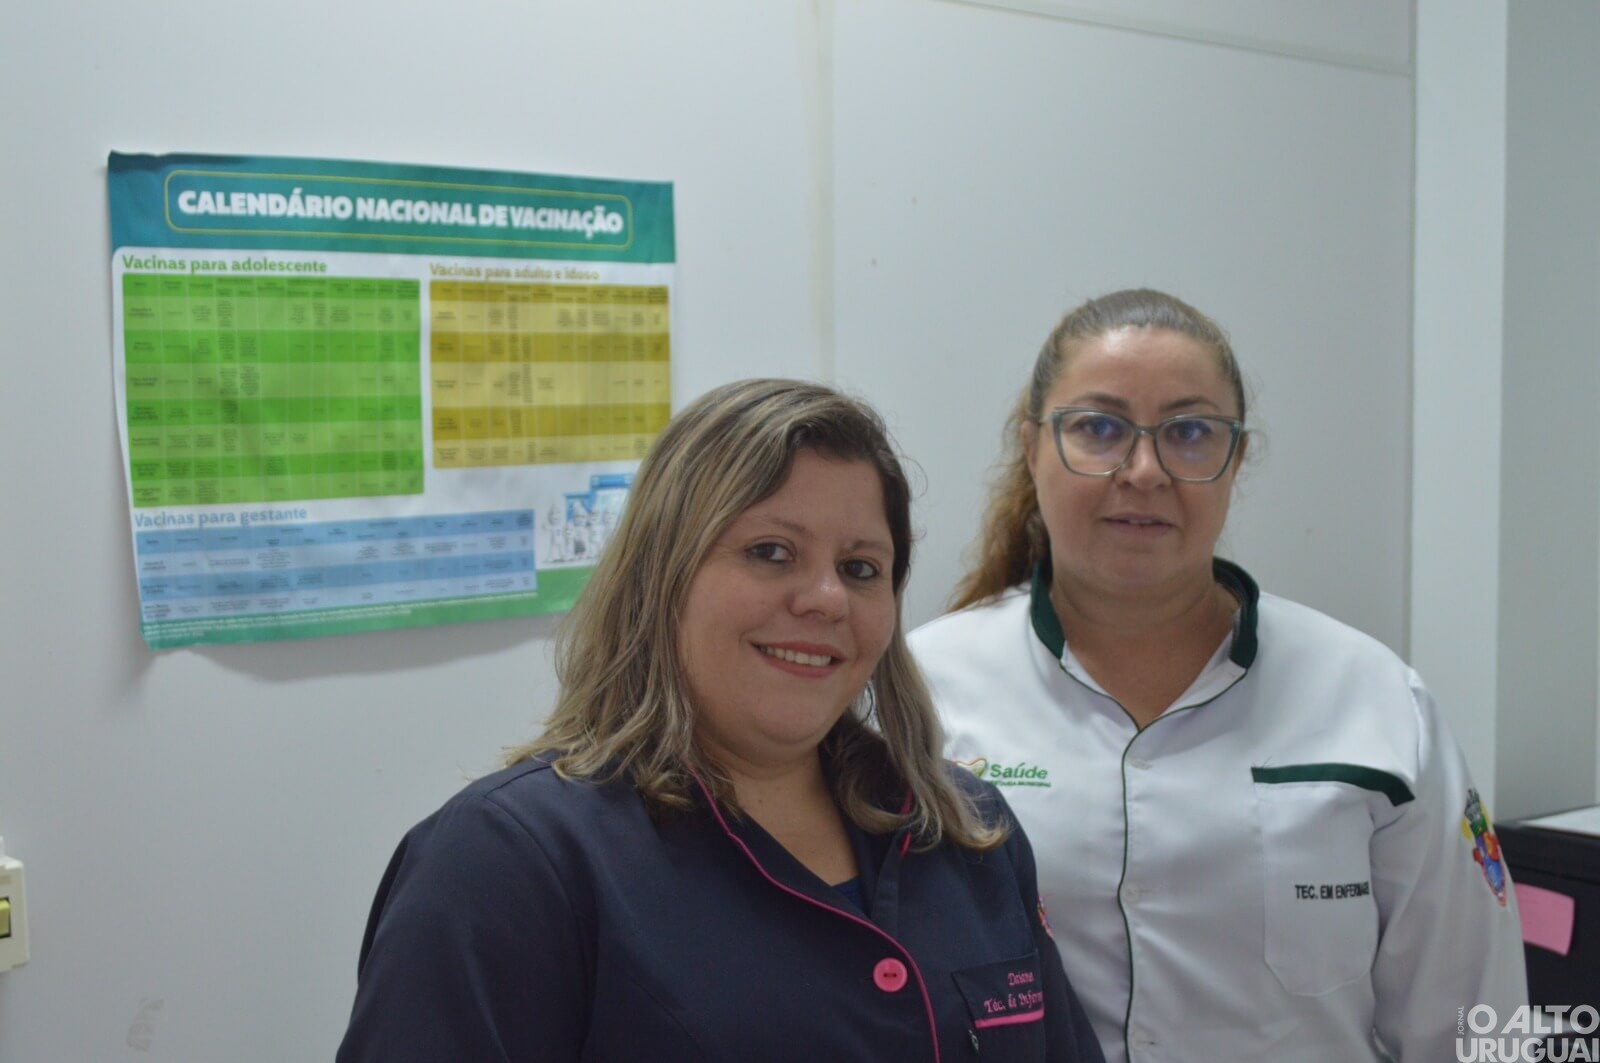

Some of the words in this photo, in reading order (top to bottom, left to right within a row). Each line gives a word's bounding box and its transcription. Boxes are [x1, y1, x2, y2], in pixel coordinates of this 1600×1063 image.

[178, 187, 353, 219] CALENDÁRIO
[356, 196, 476, 226] NACIONAL
[479, 203, 508, 227] DE
[509, 205, 623, 239] VACINAÇÃO
[122, 255, 186, 270] Vacinas
[191, 259, 227, 275] para
[232, 257, 327, 273] adolescente
[430, 263, 481, 276] Vacinas
[485, 267, 512, 280] para
[514, 266, 551, 280] adulto
[555, 269, 561, 279] e
[564, 267, 599, 280] idoso
[134, 511, 194, 527] Vacinas
[198, 511, 236, 527] para
[240, 507, 307, 525] gestante
[990, 762, 1048, 779] Saúde
[1294, 884, 1318, 900] TEC.
[1320, 884, 1333, 900] EM
